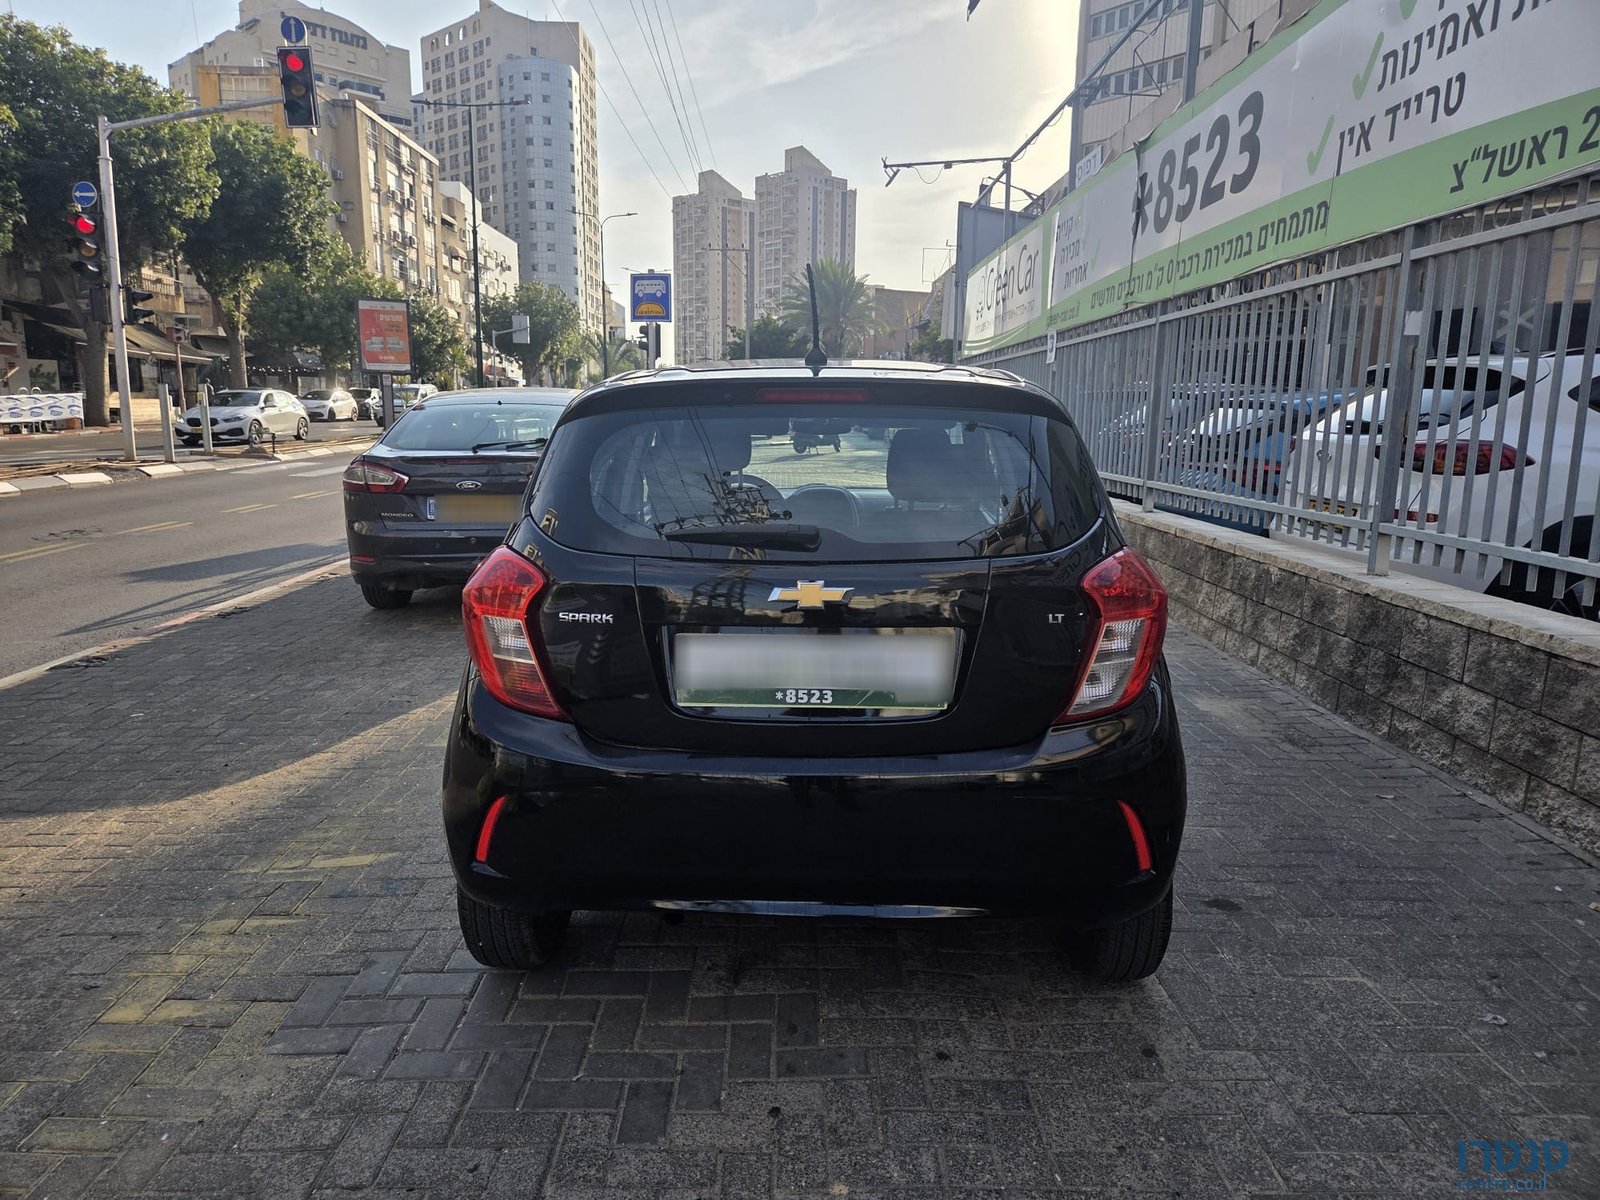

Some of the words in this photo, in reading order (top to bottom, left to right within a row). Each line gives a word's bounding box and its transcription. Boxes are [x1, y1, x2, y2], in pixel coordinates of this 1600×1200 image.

[1384, 71, 1467, 143] טרייד
[1335, 114, 1376, 177] אין
[1202, 231, 1253, 272] במכירת
[1257, 200, 1329, 252] מתמחים
[1017, 243, 1039, 295] Car
[559, 612, 614, 623] SPARK
[1048, 613, 1065, 623] LT
